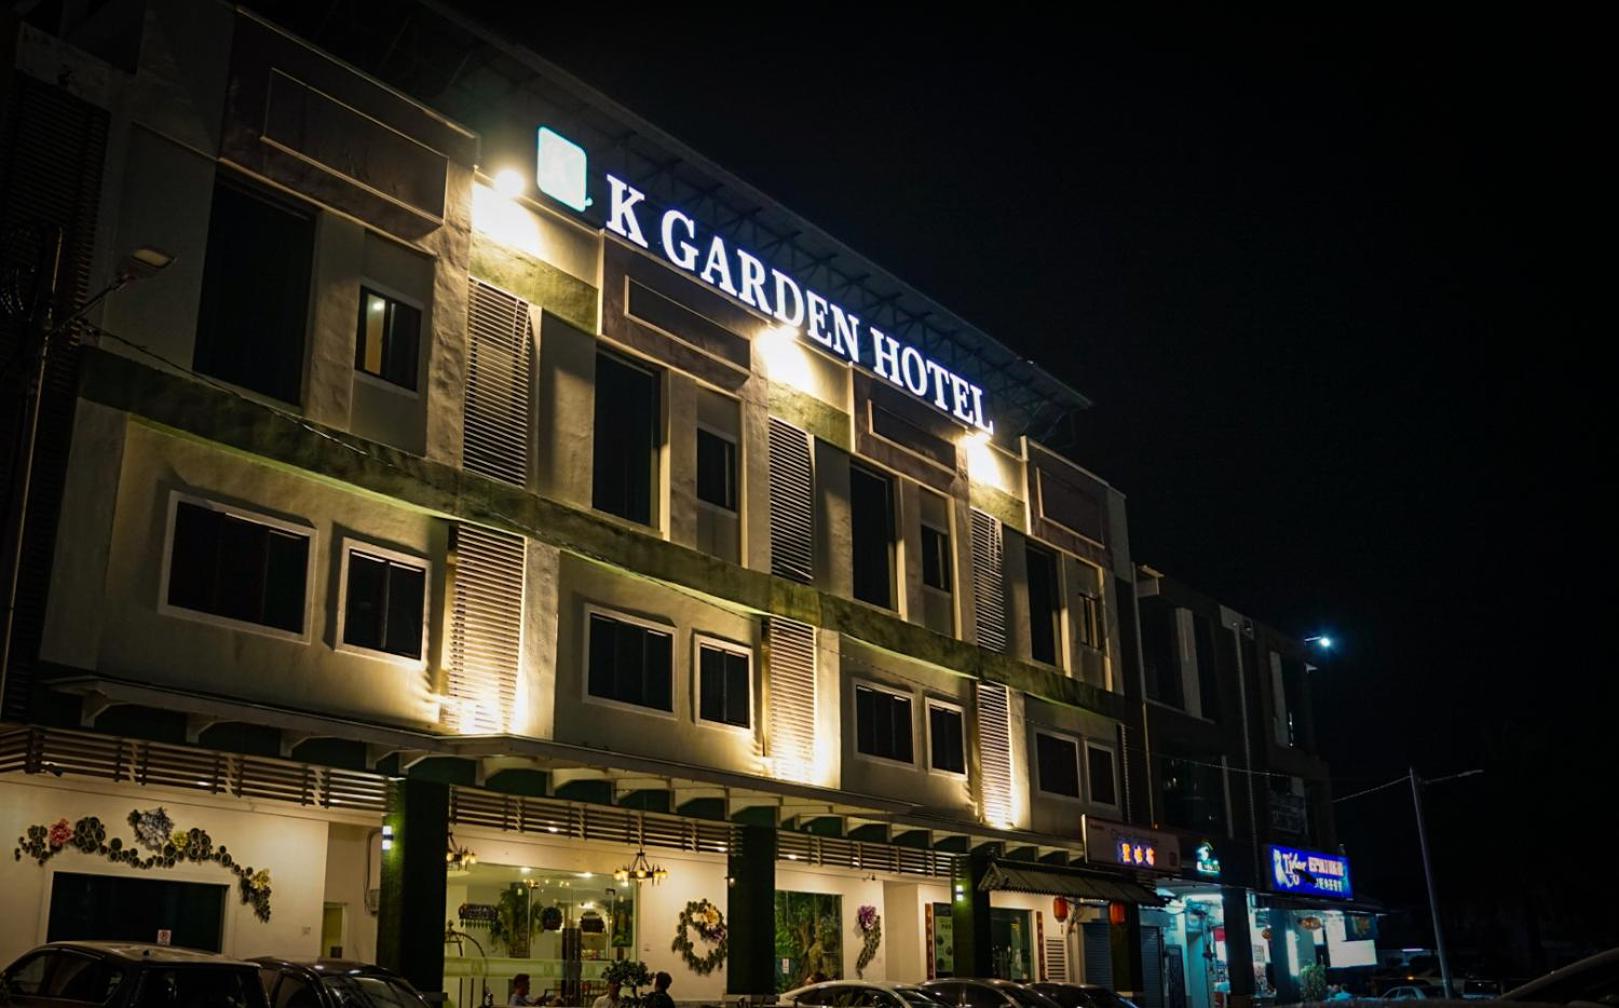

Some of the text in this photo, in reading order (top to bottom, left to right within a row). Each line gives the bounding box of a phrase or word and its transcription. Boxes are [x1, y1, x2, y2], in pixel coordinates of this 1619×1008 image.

[606, 174, 994, 434] K GARDEN HOTEL
